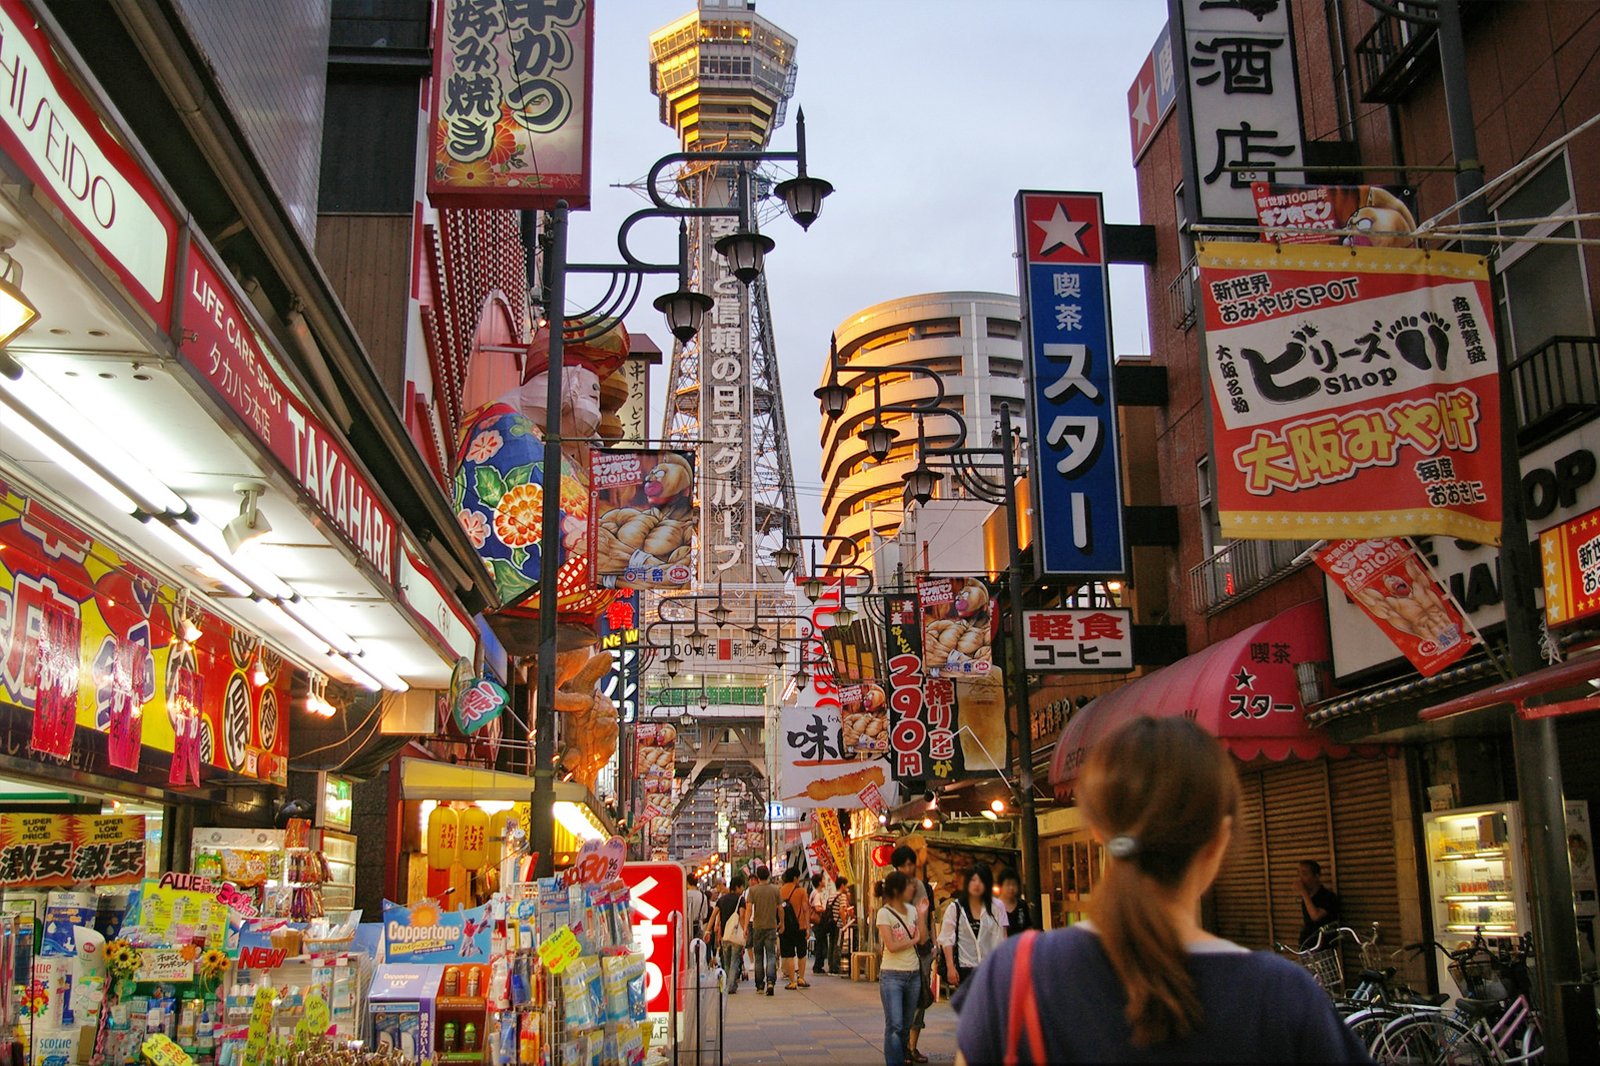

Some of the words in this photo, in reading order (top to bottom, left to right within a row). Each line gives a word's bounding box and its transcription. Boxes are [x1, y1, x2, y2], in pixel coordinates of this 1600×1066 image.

[1191, 0, 1296, 189] 酒店
[1258, 188, 1327, 207] 新世界100周年
[1260, 202, 1332, 226] キン肉マン
[1212, 273, 1271, 302] 新世界
[1053, 272, 1085, 331] 喫茶
[1220, 278, 1358, 323] おみやげSPOT
[192, 269, 224, 330] LIFE
[226, 317, 255, 376] CARE
[257, 364, 282, 414] SPOT
[1451, 296, 1487, 365] 商売繁盛
[1240, 320, 1391, 405] ビリーズ
[1215, 344, 1250, 414] 大阪名物
[1325, 366, 1397, 395] Shop
[209, 342, 271, 445] タカハラ本店
[1043, 343, 1100, 549] スター
[1238, 389, 1476, 491] 大阪みやげ
[593, 470, 642, 486] PROJECT
[1416, 458, 1455, 482] 毎度
[287, 402, 393, 588] TAKAHARA
[1429, 482, 1486, 506] おおきに
[1029, 612, 1124, 642] 軽食
[1033, 643, 1122, 665] コーヒー
[1250, 642, 1291, 664] 喫茶
[889, 653, 927, 777] 290円
[1229, 694, 1296, 719] スター
[22, 817, 52, 826] SUPER
[27, 825, 46, 833] LOW
[94, 818, 123, 826] SUPER
[99, 825, 118, 833] LOW
[22, 832, 51, 840] PRICE!
[94, 832, 123, 840] PRICE!
[388, 920, 461, 943] Coppertone
[238, 946, 288, 969] NEW
